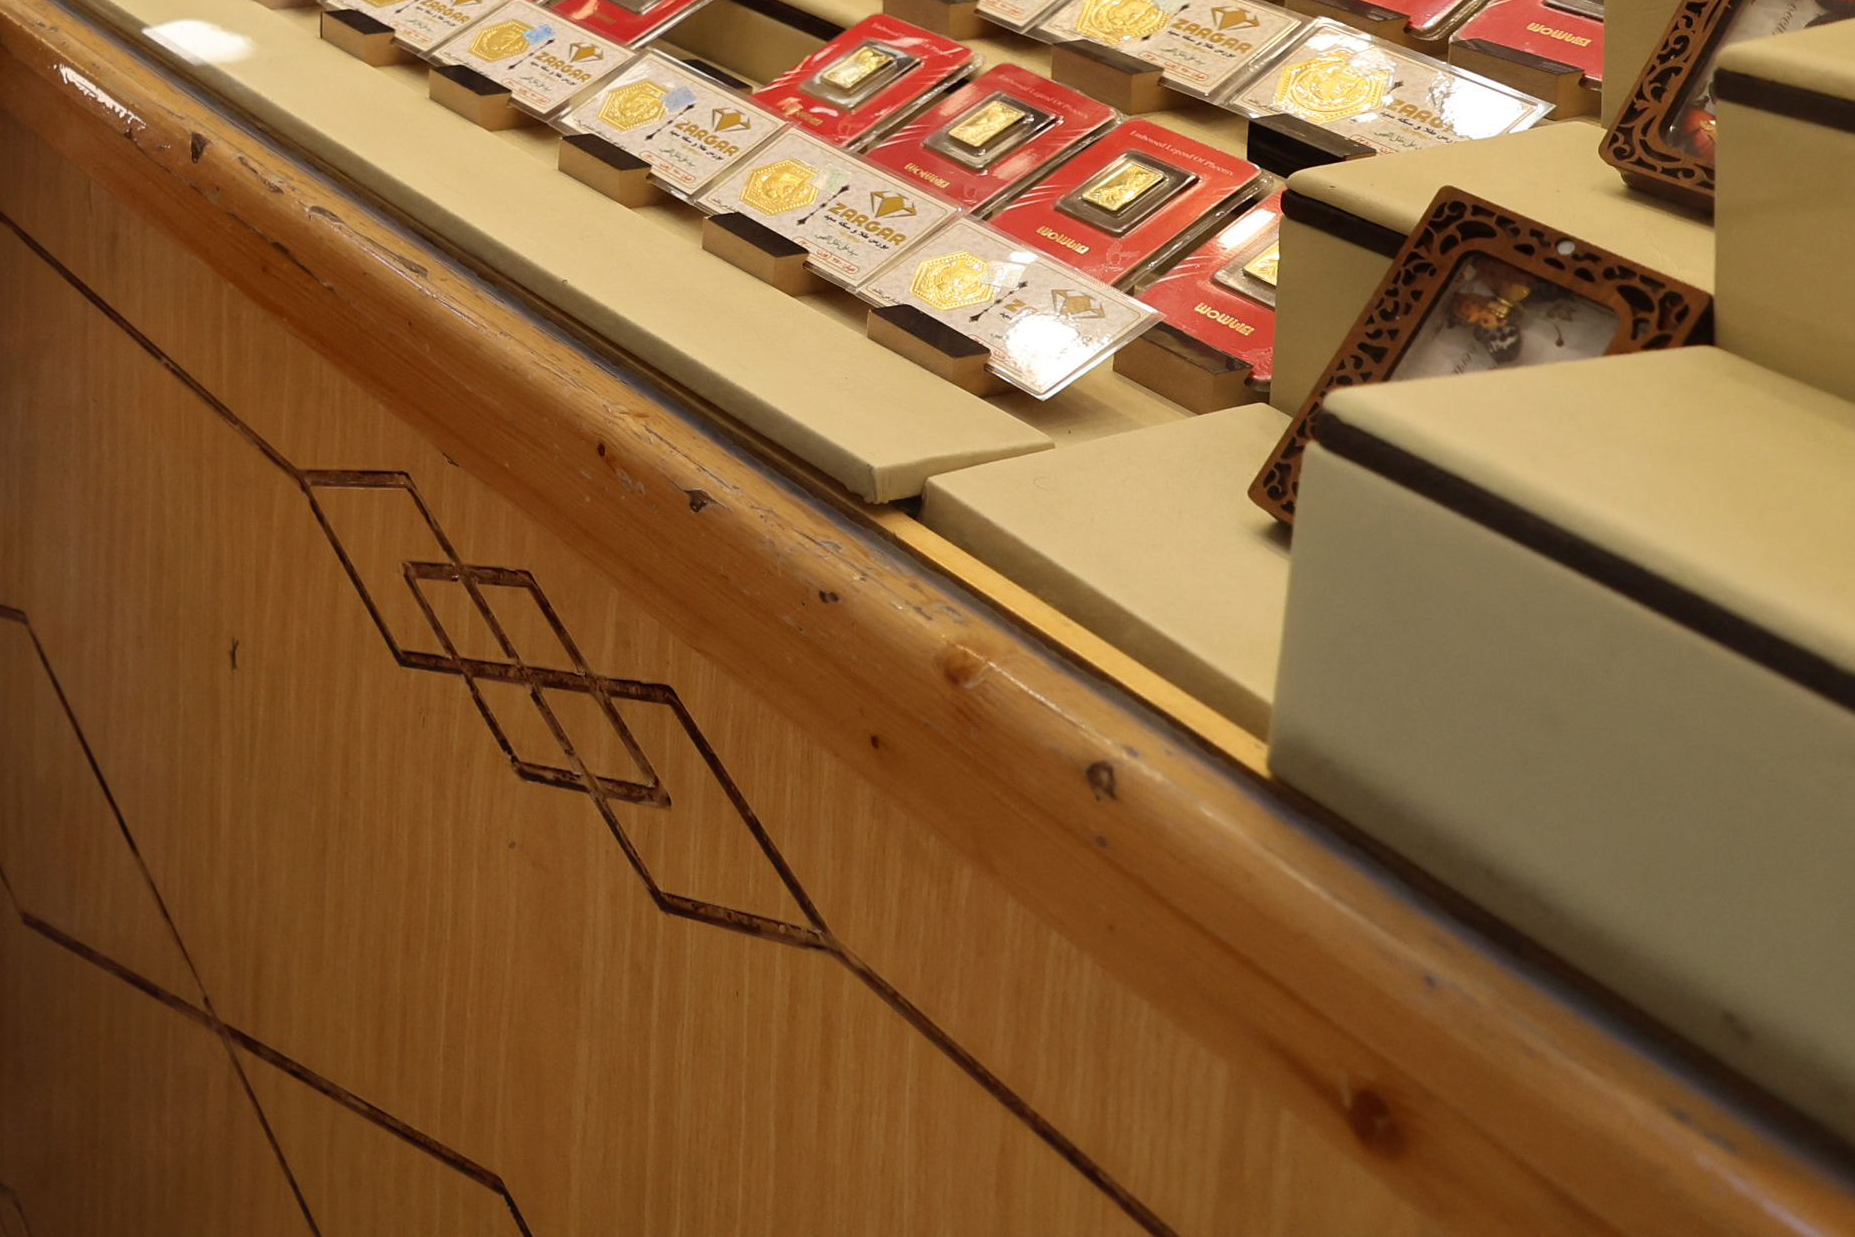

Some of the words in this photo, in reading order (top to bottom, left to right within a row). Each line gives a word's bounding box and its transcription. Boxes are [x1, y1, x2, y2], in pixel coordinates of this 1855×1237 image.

[1170, 18, 1254, 53] ZARGAR
[533, 51, 592, 82] ZARGAR
[673, 118, 741, 157] ZARGAR
[827, 201, 908, 246] ZARGAR
